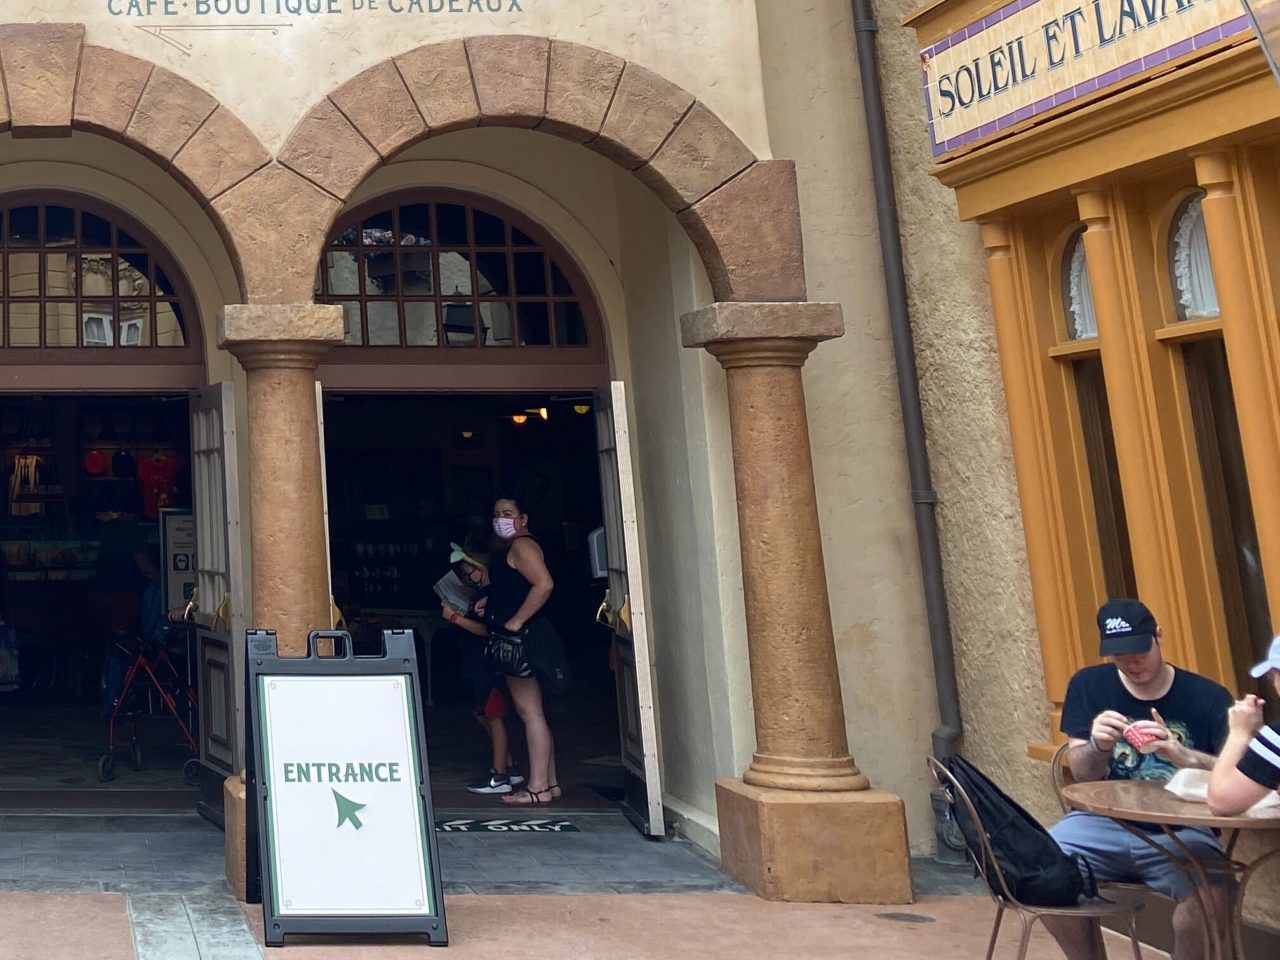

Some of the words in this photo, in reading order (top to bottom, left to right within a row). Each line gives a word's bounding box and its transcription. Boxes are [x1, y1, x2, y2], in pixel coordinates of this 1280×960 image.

[937, 36, 1037, 118] SOLEIL
[1041, 7, 1087, 70] ET
[283, 761, 402, 783] ENTRANCE
[487, 824, 563, 832] ONLY
